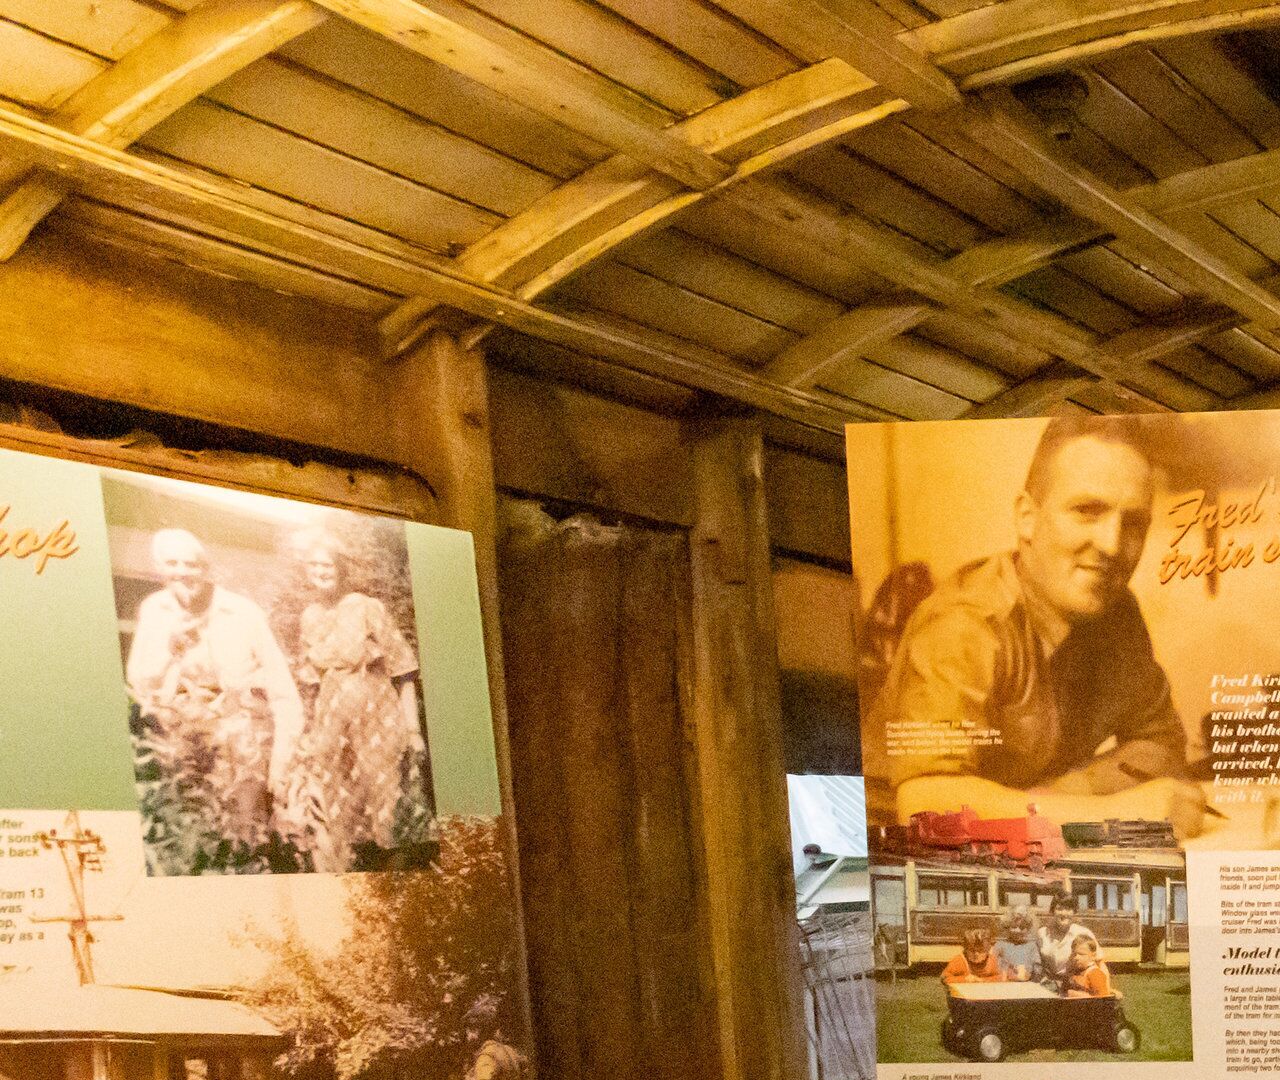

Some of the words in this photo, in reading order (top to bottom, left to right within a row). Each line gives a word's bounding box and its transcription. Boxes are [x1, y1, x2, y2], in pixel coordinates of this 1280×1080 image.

[1159, 538, 1255, 584] train
[1211, 674, 1249, 687] Fred
[1210, 707, 1267, 720] wanted
[1269, 710, 1280, 719] a
[1211, 724, 1234, 736] his
[1212, 740, 1238, 753] but
[1240, 740, 1279, 753] when
[1212, 756, 1273, 770] arrived,
[1213, 773, 1254, 786] know
[9, 847, 39, 857] back
[30, 888, 44, 899] 13
[1222, 947, 1271, 960] Model
[1226, 1065, 1258, 1073] acquiring
